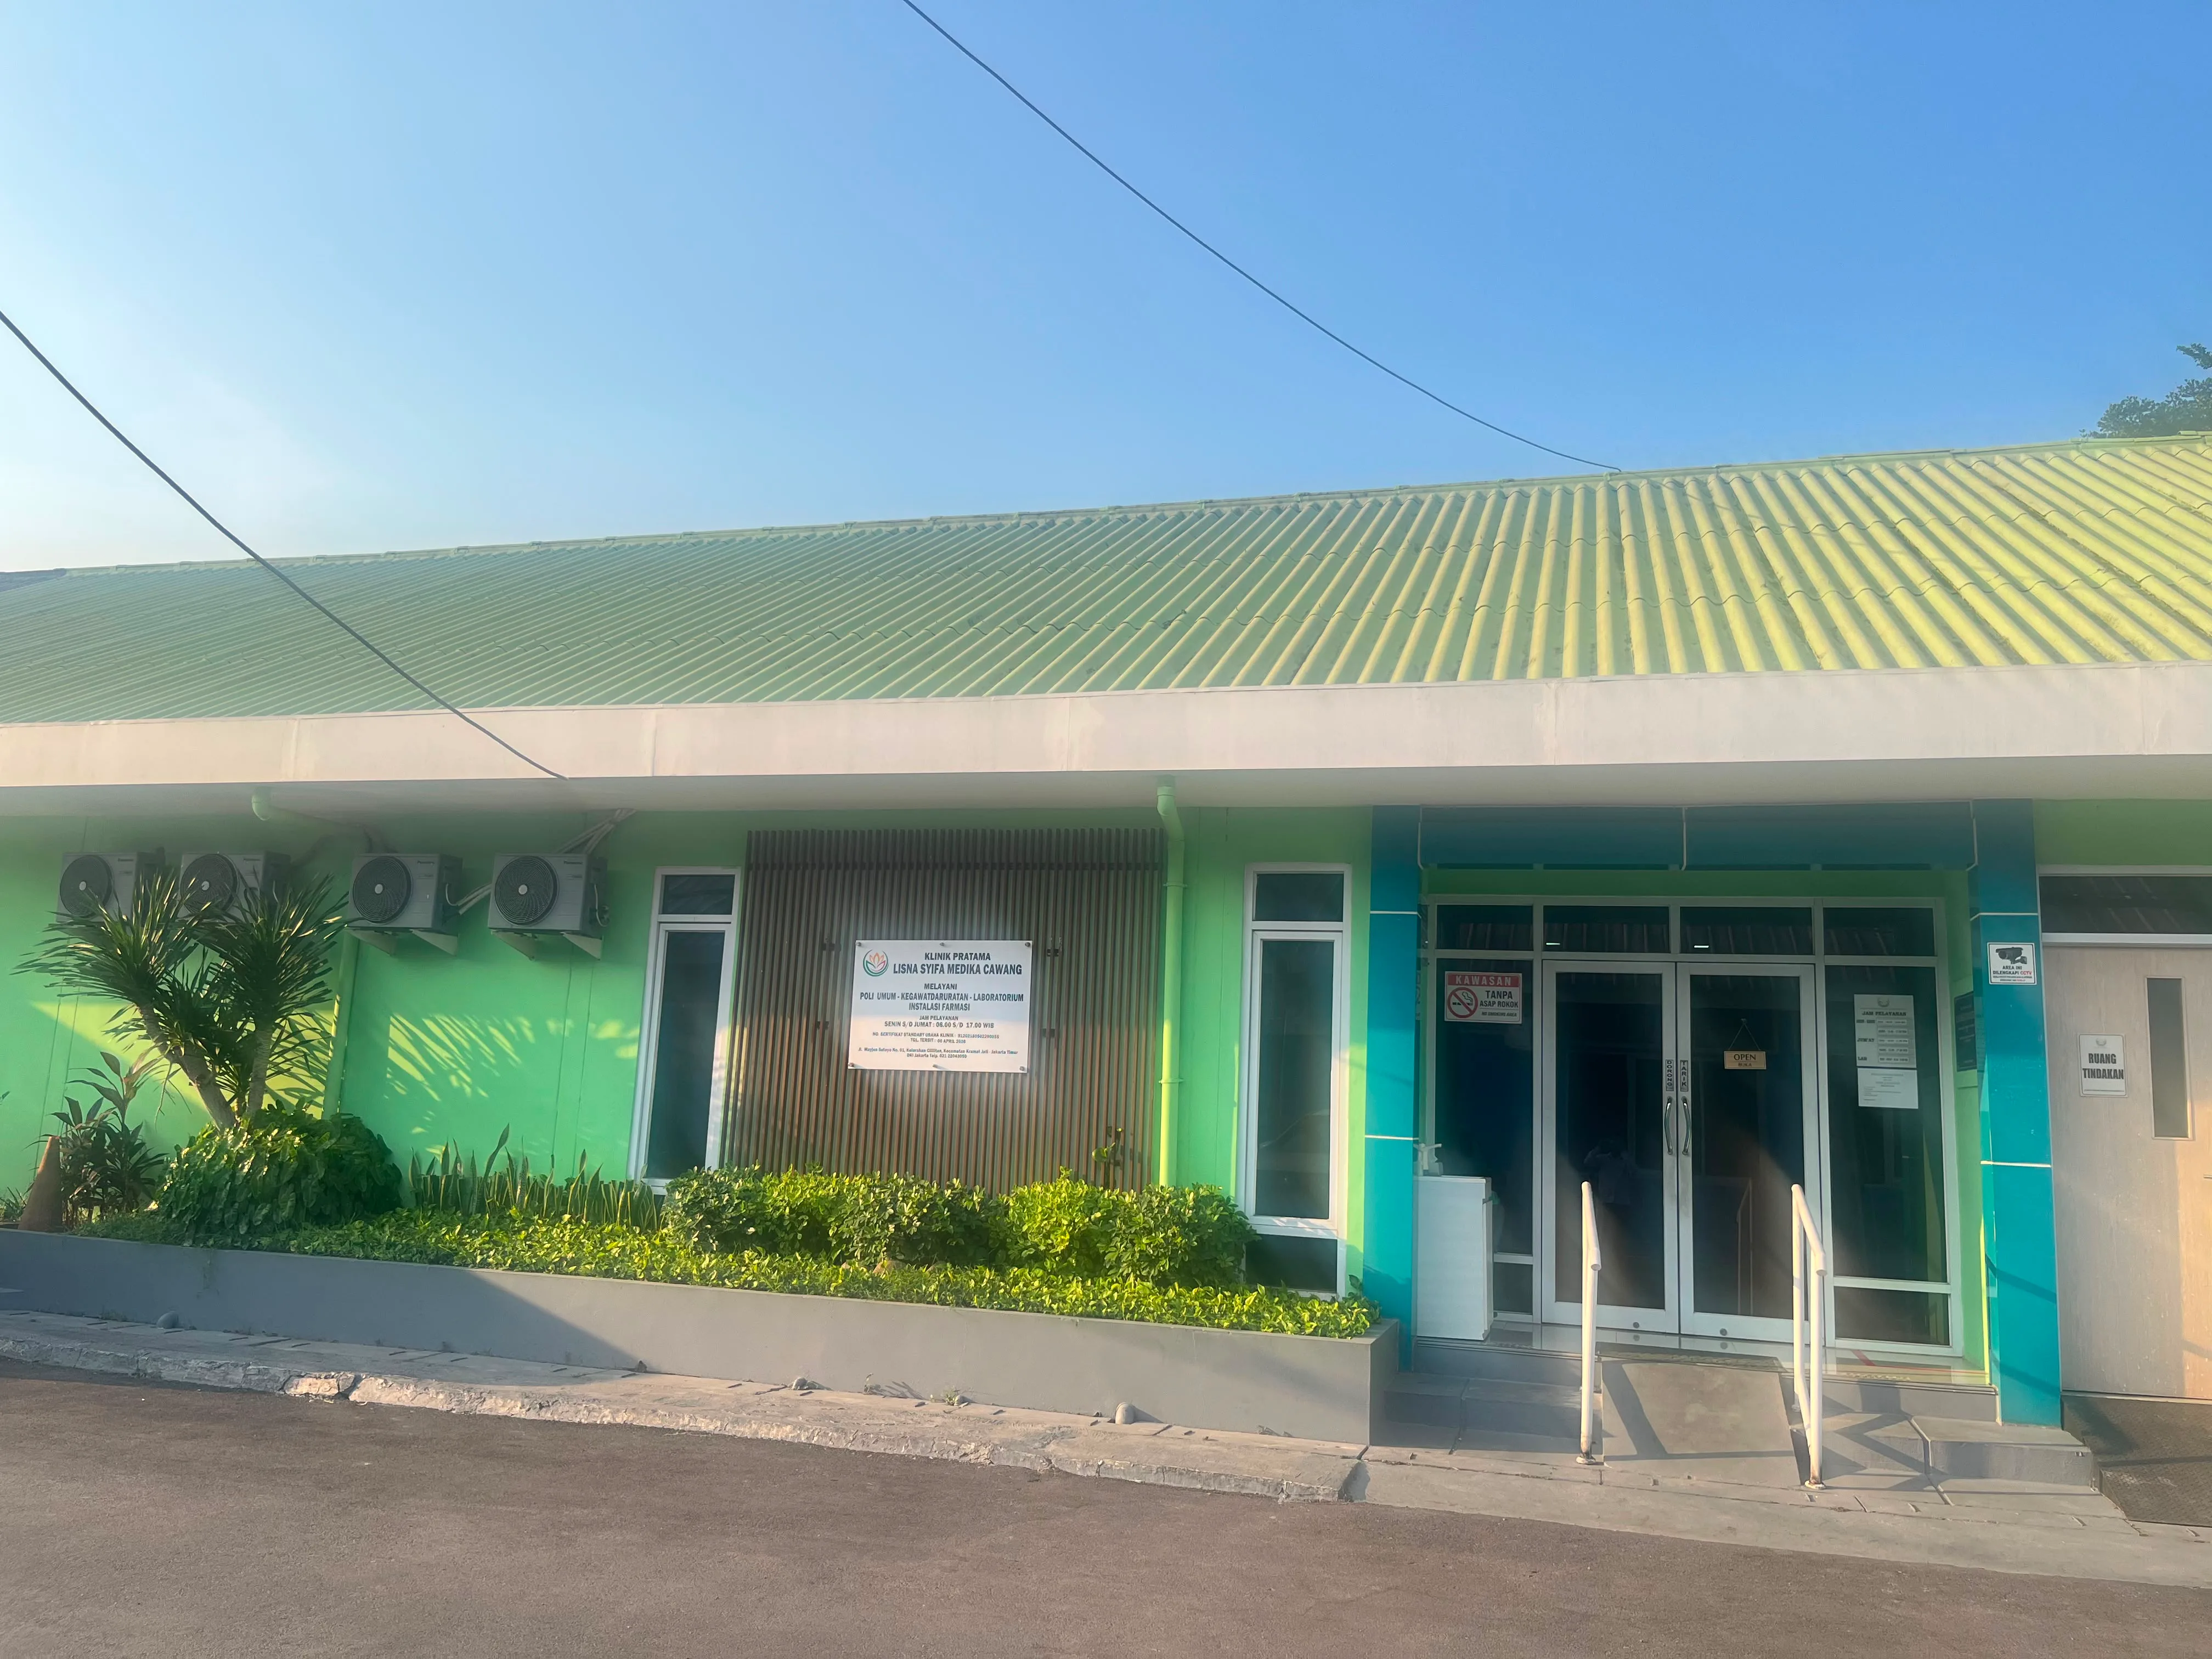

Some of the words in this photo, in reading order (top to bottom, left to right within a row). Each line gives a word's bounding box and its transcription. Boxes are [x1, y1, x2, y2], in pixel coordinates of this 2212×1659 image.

[953, 952, 991, 961] PRATAMA
[893, 963, 918, 974] LISNA
[920, 963, 945, 974] SYIFA
[947, 964, 981, 974] MEDIKA
[983, 964, 1022, 975] CAWANG
[1456, 975, 1511, 986] KAWASAN
[901, 992, 968, 1001] KEGAWATDARURATAN
[973, 993, 1024, 1002] LABORATORIUM
[1485, 990, 1513, 1000] TANPA
[909, 1002, 940, 1011] INSTALASI
[942, 1003, 970, 1011] FARMASI
[2089, 1053, 2117, 1064] RUANG
[2082, 1068, 2124, 1079] TINDAKAN
